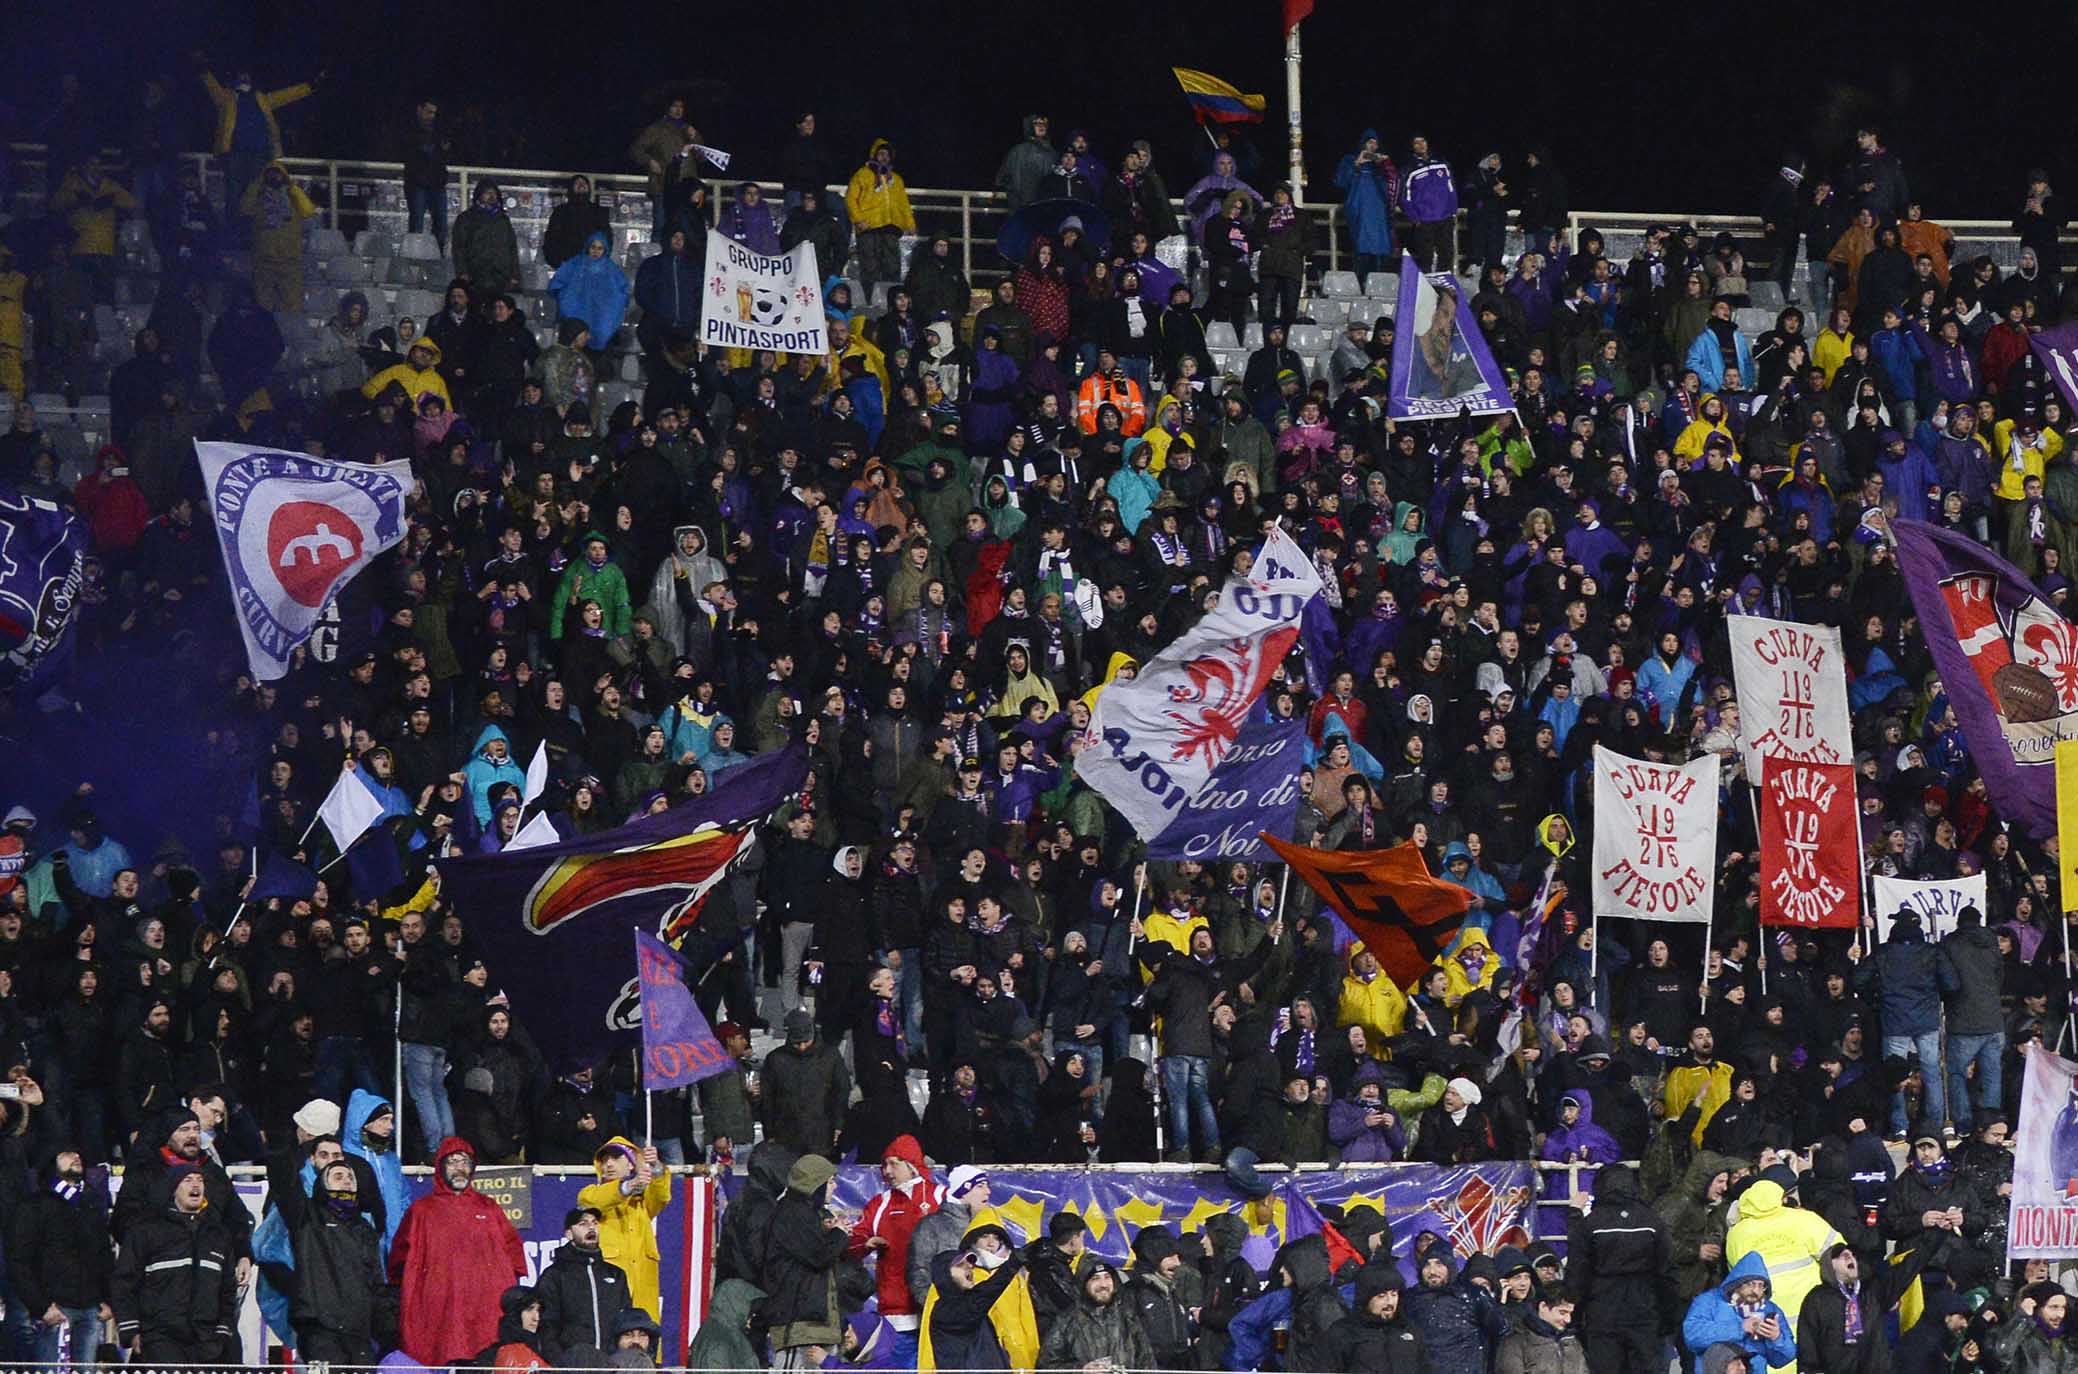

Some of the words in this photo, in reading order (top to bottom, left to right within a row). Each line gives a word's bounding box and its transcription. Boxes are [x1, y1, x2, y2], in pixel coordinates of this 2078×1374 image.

[728, 244, 793, 276] GRUPPO
[707, 319, 821, 350] PINTASPORT
[1754, 628, 1825, 673] CURVA
[1258, 774, 1299, 808] di
[1610, 764, 1696, 805] CURVA
[1770, 768, 1838, 814] CURVA
[1184, 821, 1266, 857] Noi
[1602, 858, 1705, 913] FIESOLE
[1771, 867, 1846, 922] FIESOLE
